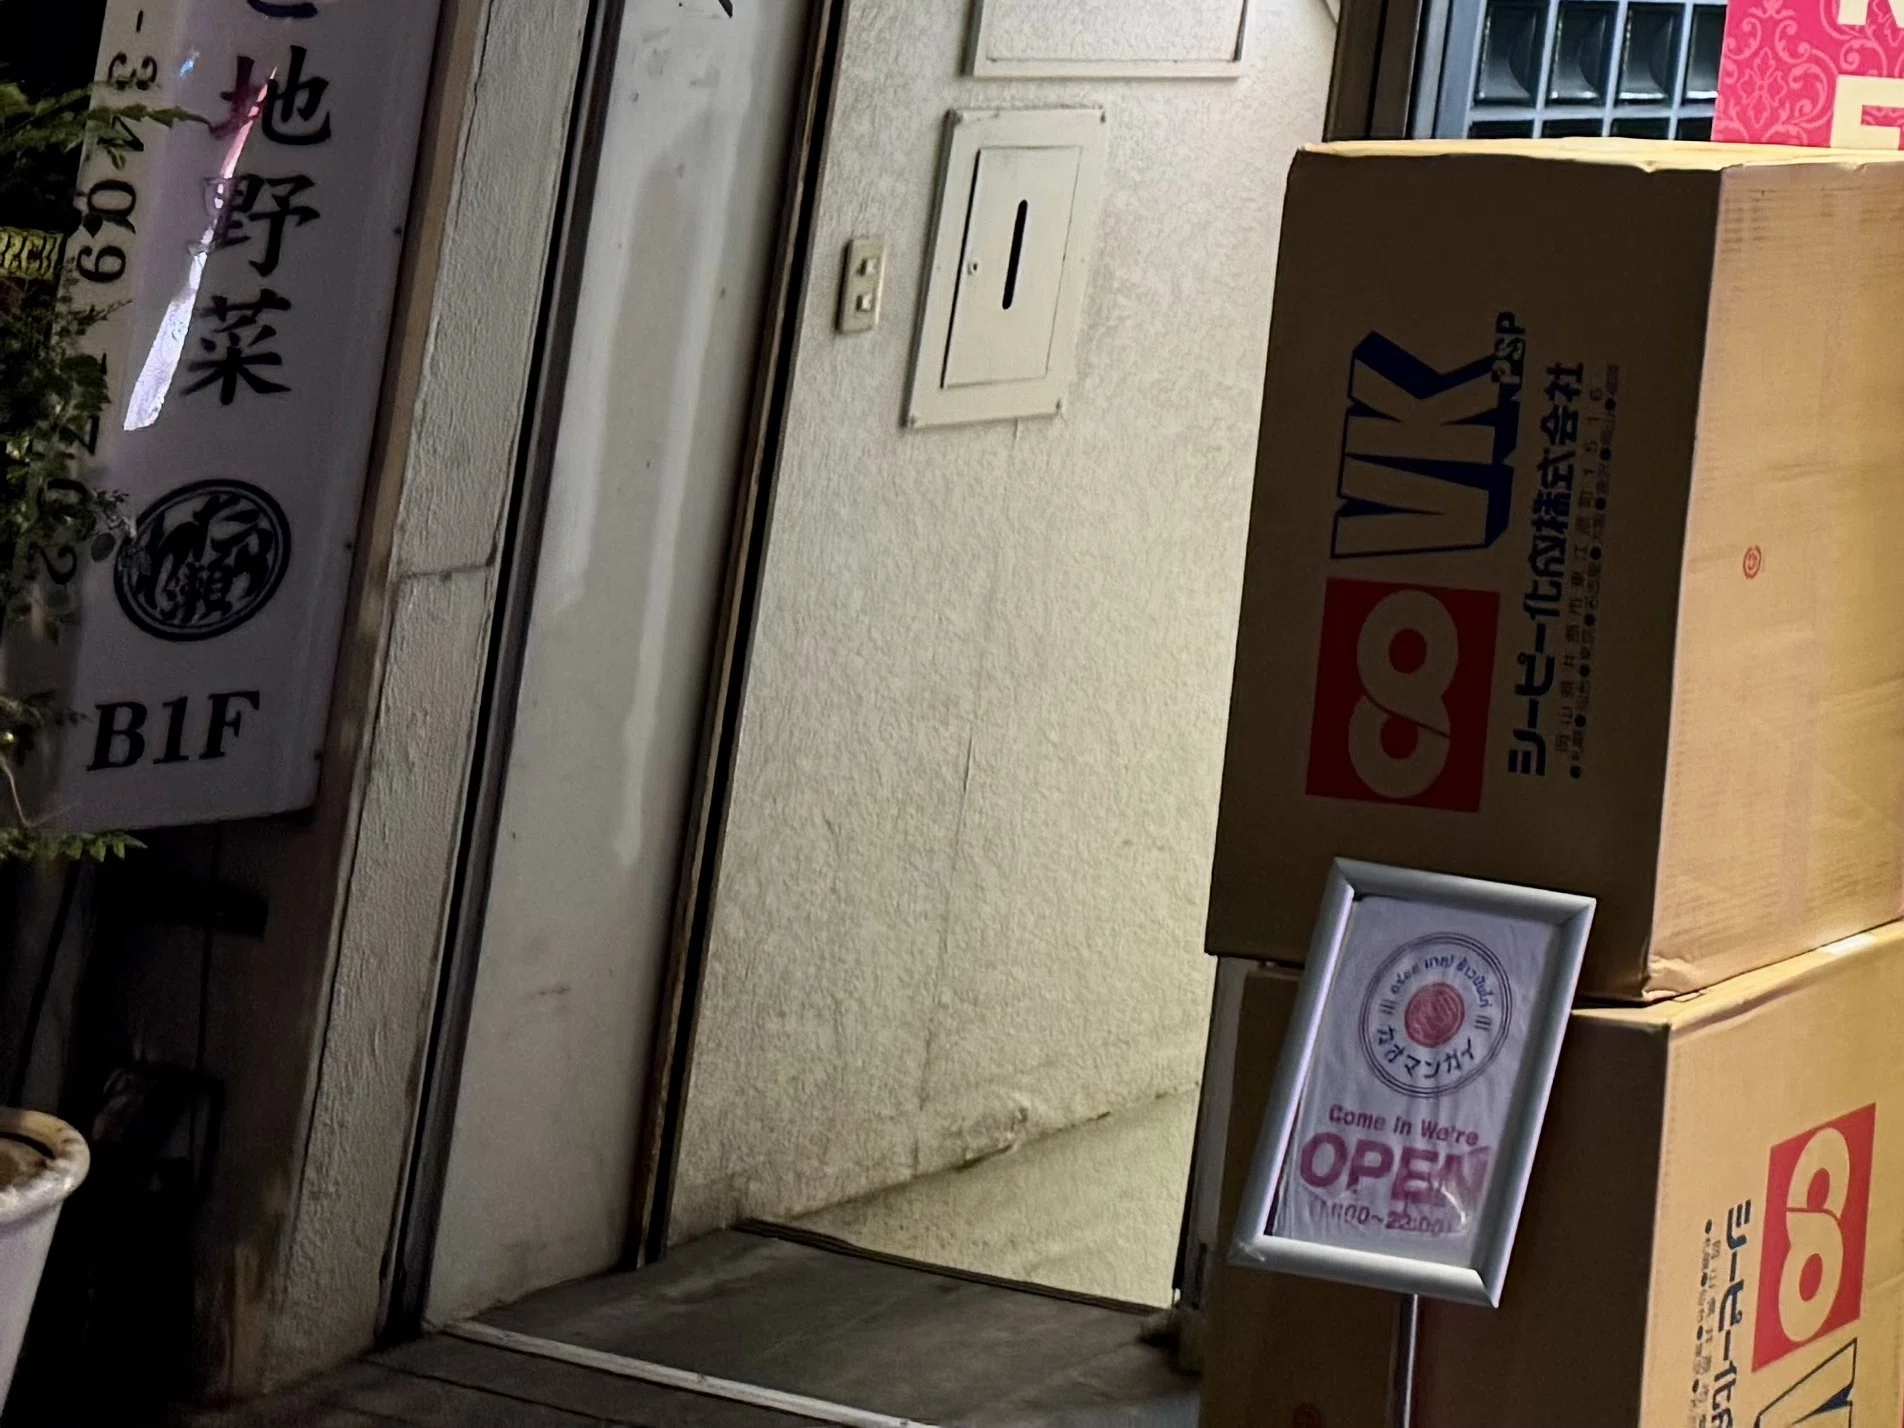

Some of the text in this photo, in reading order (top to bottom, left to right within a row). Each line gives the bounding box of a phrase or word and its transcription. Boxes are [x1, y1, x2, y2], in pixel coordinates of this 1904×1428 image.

[86, 688, 263, 775] B1F
[1329, 1104, 1386, 1131] Come
[1299, 1132, 1492, 1208] OPEN
